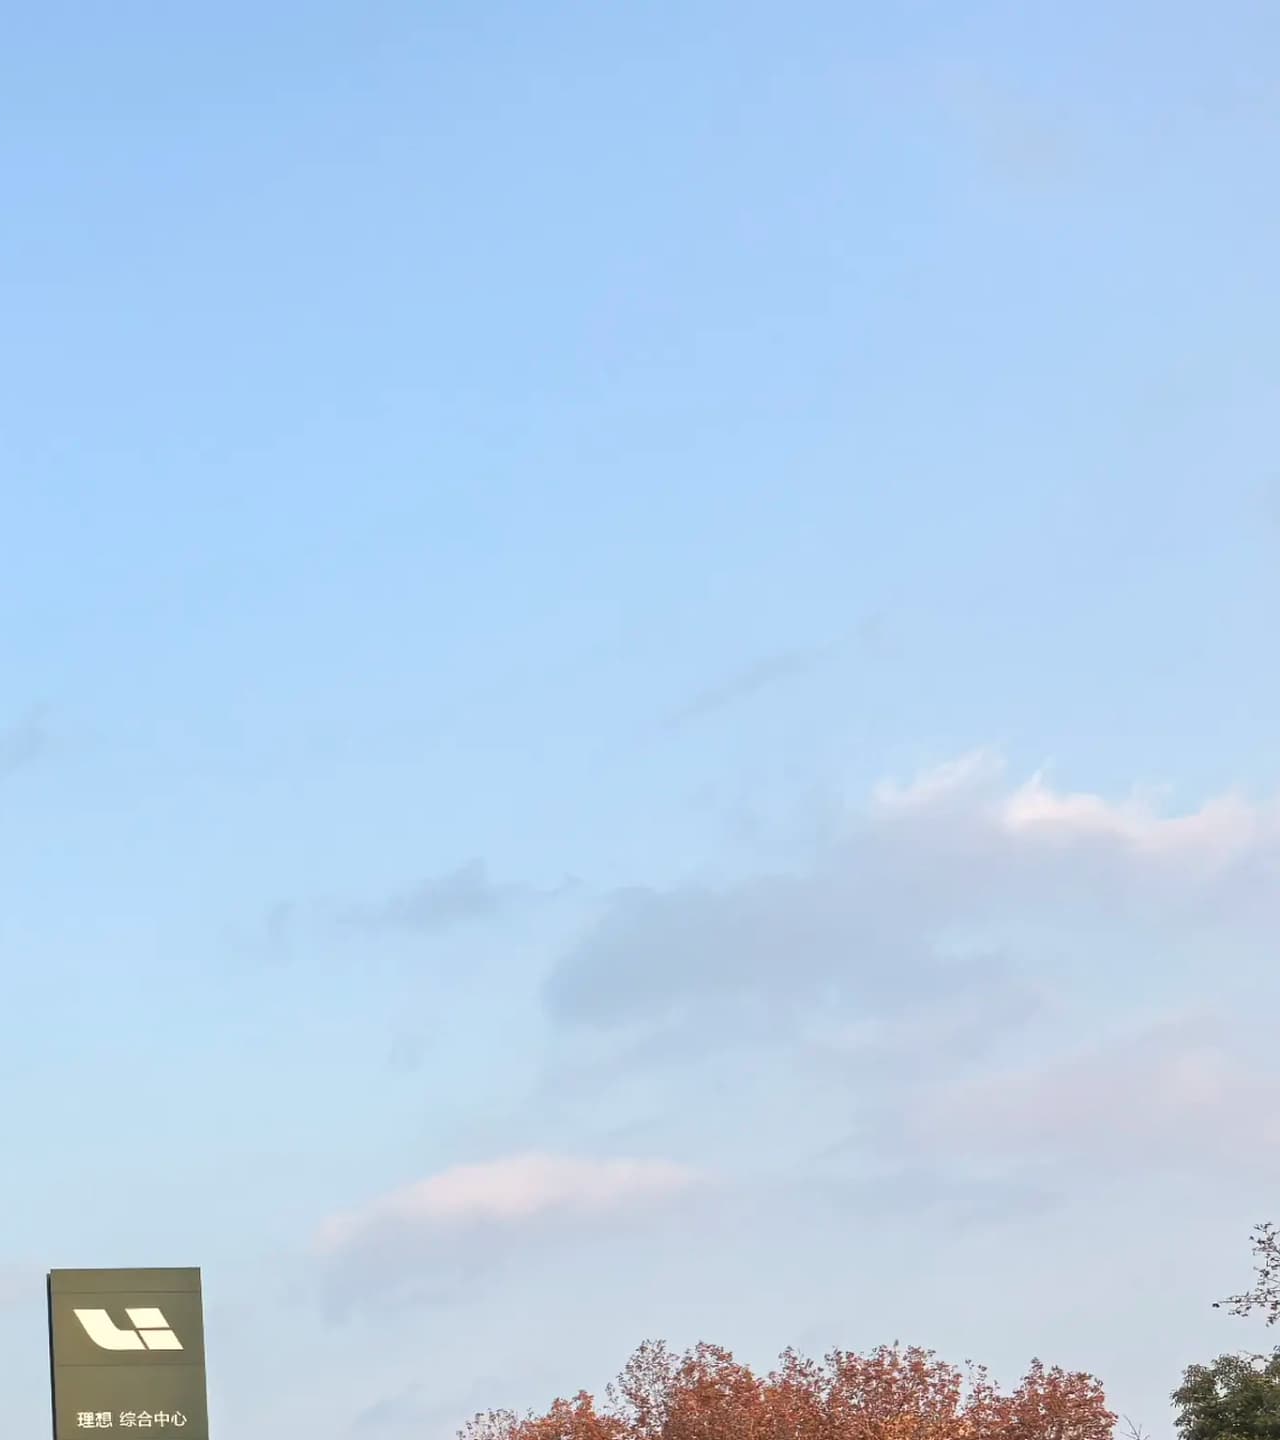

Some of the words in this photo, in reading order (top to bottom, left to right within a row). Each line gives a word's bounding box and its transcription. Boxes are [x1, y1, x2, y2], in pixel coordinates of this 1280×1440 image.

[76, 1410, 113, 1429] 理想
[119, 1410, 188, 1428] 综合中心
